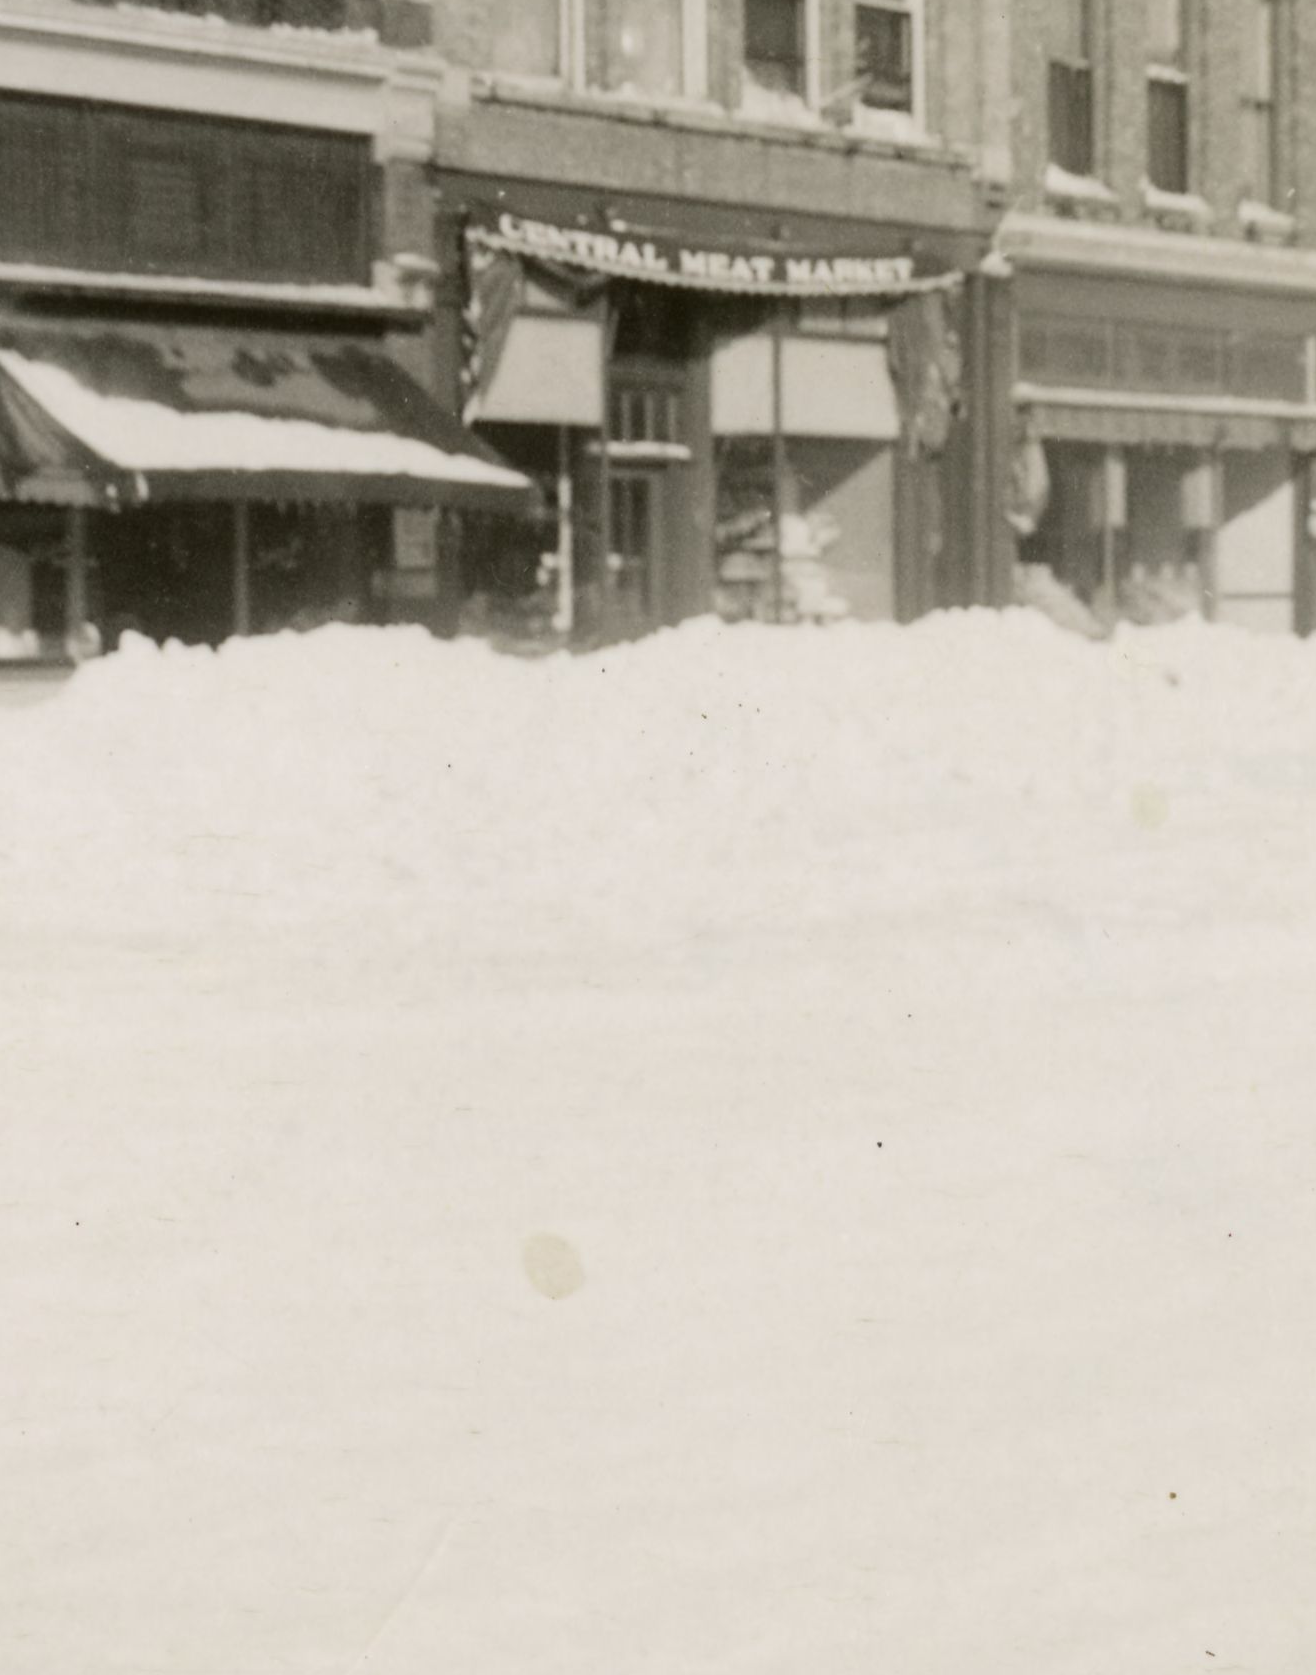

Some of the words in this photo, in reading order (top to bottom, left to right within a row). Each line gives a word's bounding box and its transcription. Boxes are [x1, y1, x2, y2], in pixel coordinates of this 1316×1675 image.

[498, 212, 669, 271] CENTRAL
[679, 248, 775, 283] MEAT
[785, 256, 914, 285] MARKET
